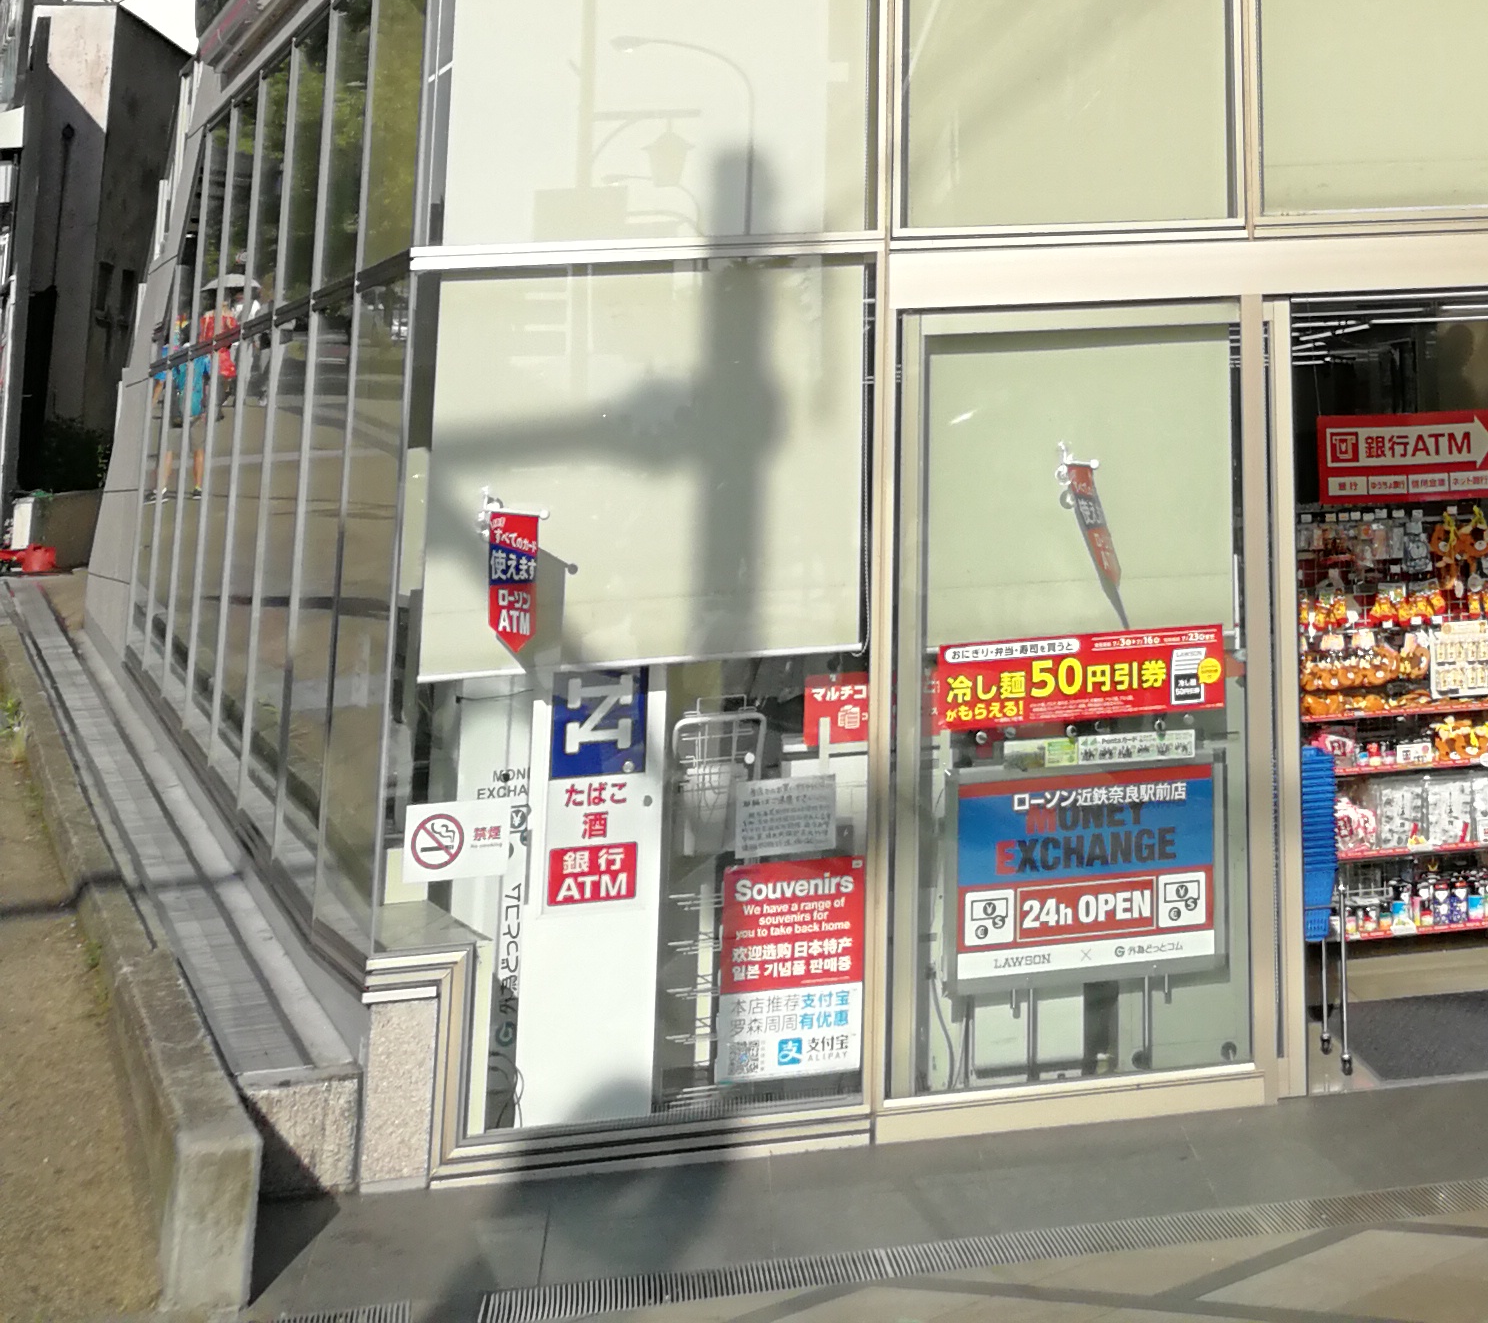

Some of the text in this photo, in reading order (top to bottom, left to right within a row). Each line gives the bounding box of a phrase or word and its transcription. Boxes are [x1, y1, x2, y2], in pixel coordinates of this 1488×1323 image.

[1364, 431, 1471, 458] 銀行ATM
[490, 550, 537, 580] 使えます
[498, 609, 531, 636] ATM
[945, 657, 1167, 703] 冷し麺50円引券
[945, 700, 1024, 722] がもらえる!
[564, 781, 628, 808] たばこ
[1013, 782, 1188, 811] ローソン近鉄奈良駅前店
[581, 811, 609, 840] 酒
[1025, 803, 1143, 835] MONEY
[562, 846, 625, 874] 銀行
[995, 826, 1176, 875] EXCHANGE
[556, 872, 628, 902] ATM
[734, 872, 855, 902] Souvenirs
[743, 897, 846, 916] We have a range of
[758, 910, 829, 926] souvenirs for
[1022, 889, 1151, 929] 24h OPEN
[735, 921, 851, 941] you to take back home
[732, 963, 760, 982] 일본
[993, 952, 1052, 969] LAWSON
[731, 990, 850, 1016] 本店推荐支付宝
[730, 1009, 850, 1036] 罗森周周有优惠
[806, 1034, 849, 1054] 支付宝
